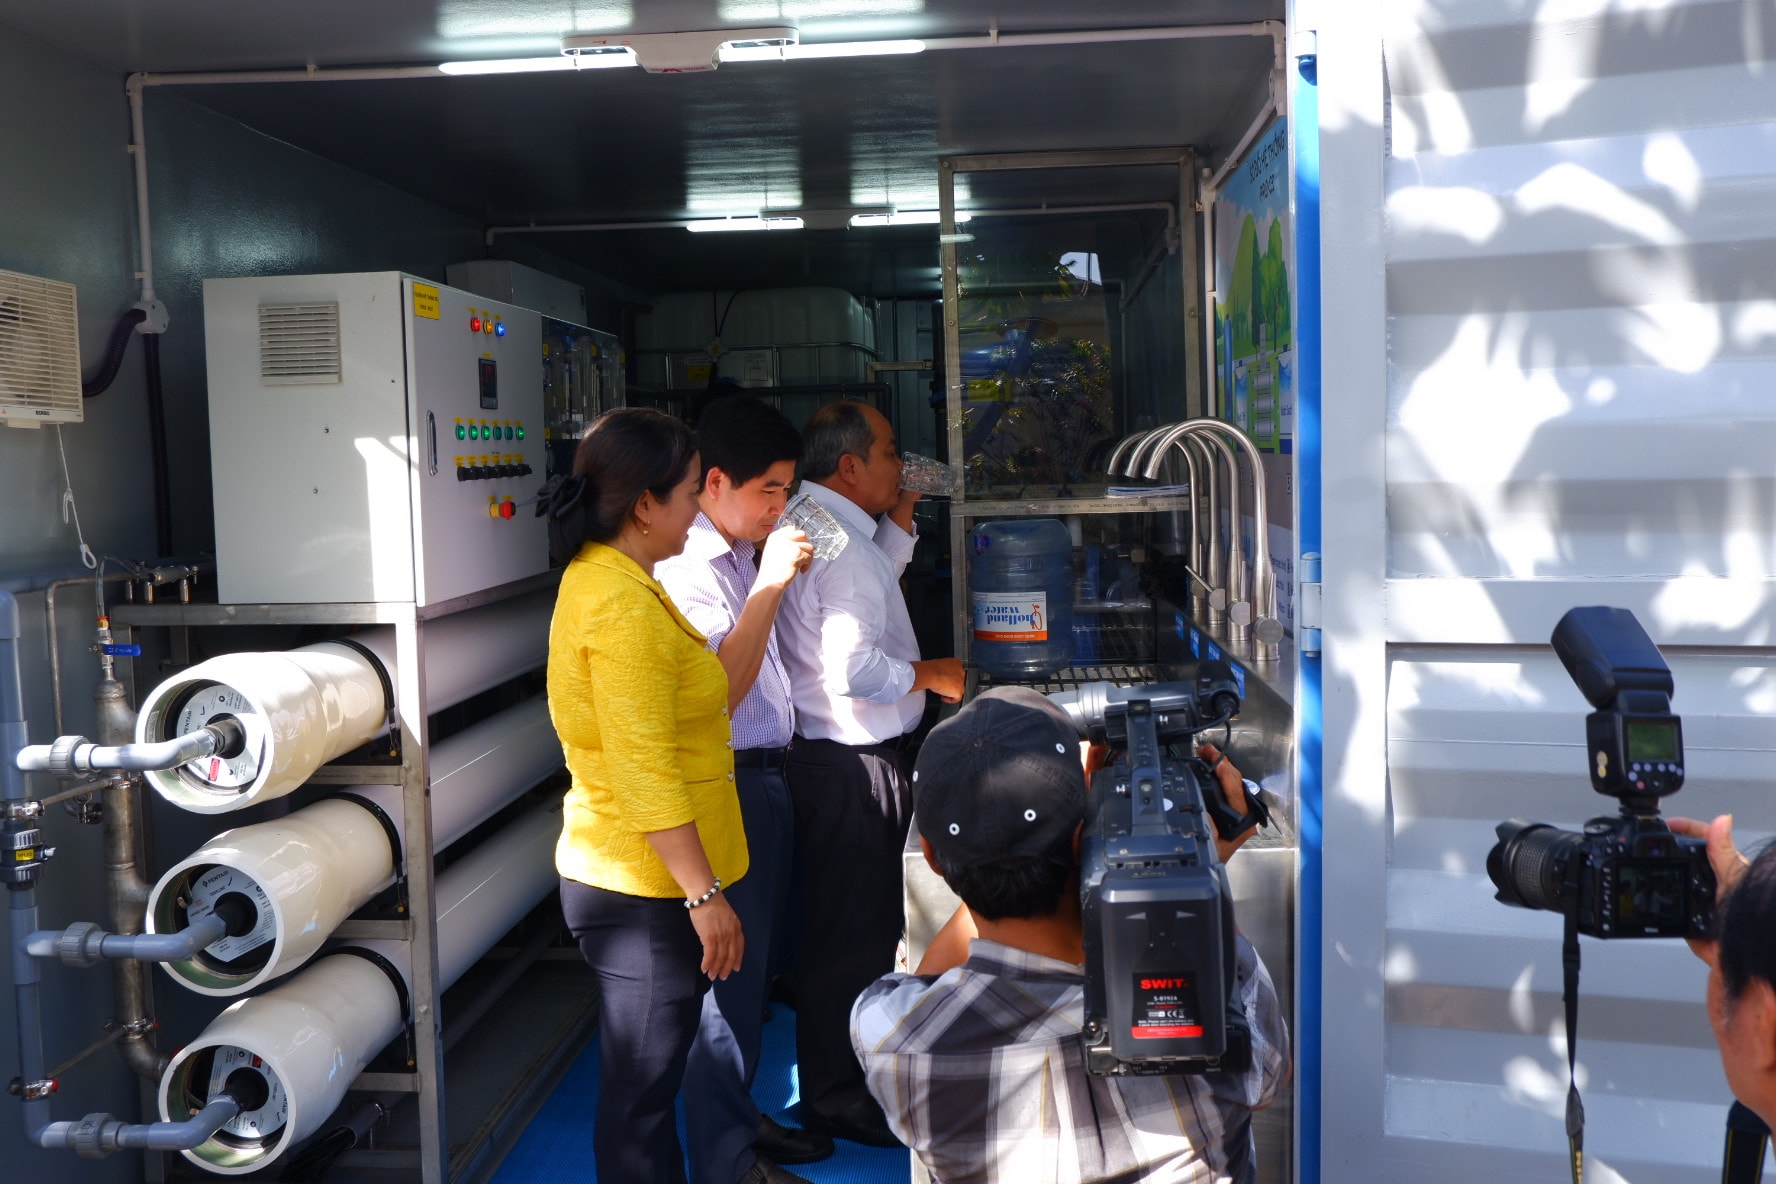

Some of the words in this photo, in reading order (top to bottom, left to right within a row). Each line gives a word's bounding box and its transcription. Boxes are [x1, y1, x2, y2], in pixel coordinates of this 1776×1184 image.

[984, 606, 1020, 615] water
[987, 614, 1034, 626] holland
[207, 870, 230, 884] PENTAIR
[1140, 978, 1185, 990] SWIT
